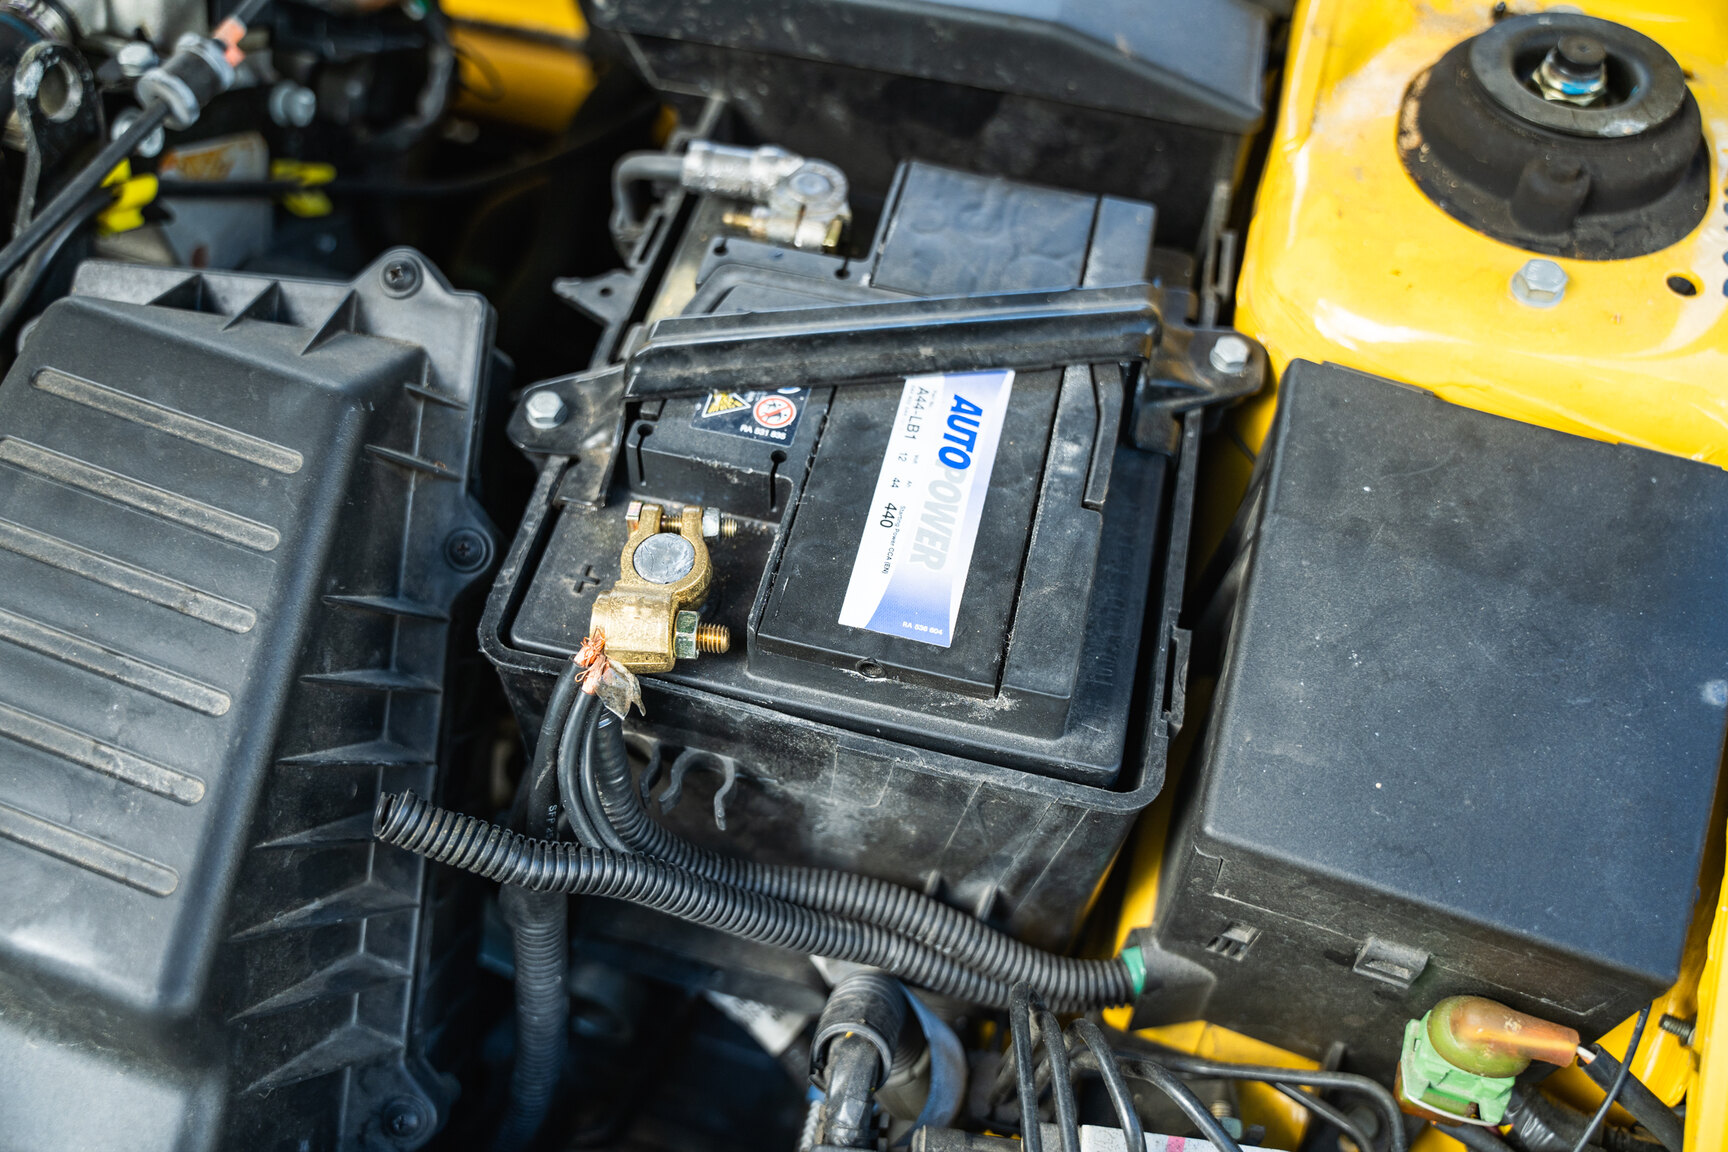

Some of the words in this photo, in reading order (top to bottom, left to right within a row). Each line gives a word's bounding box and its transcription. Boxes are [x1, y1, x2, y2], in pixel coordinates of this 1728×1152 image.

[905, 386, 929, 440] A44-LB1
[898, 452, 908, 462] 12
[891, 477, 900, 488] 44
[879, 501, 898, 529] 440
[889, 527, 901, 547] Power
[886, 546, 895, 561] CCA
